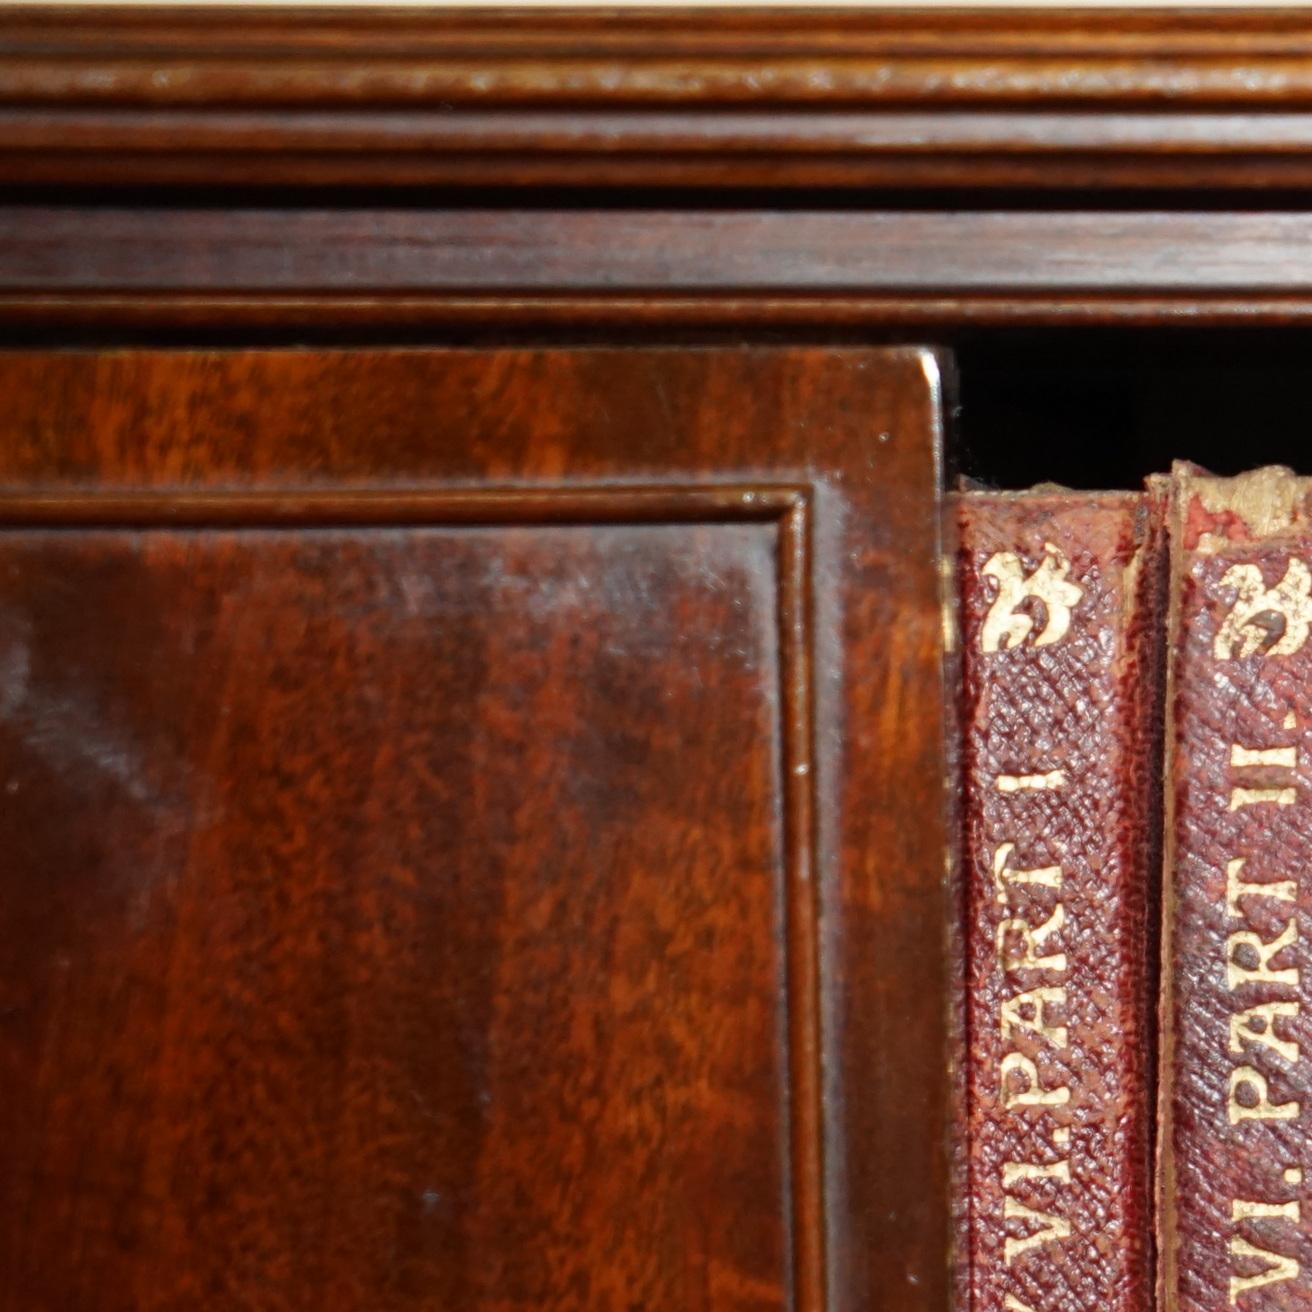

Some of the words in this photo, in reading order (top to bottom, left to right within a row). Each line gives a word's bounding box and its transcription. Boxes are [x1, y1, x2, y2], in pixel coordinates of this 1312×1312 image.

[999, 770, 1066, 791] I
[1230, 714, 1297, 811] II.
[995, 843, 1071, 1109] PART
[1228, 858, 1299, 1124] PART
[1003, 1128, 1072, 1264] VI.
[1230, 1168, 1301, 1304] VI.
